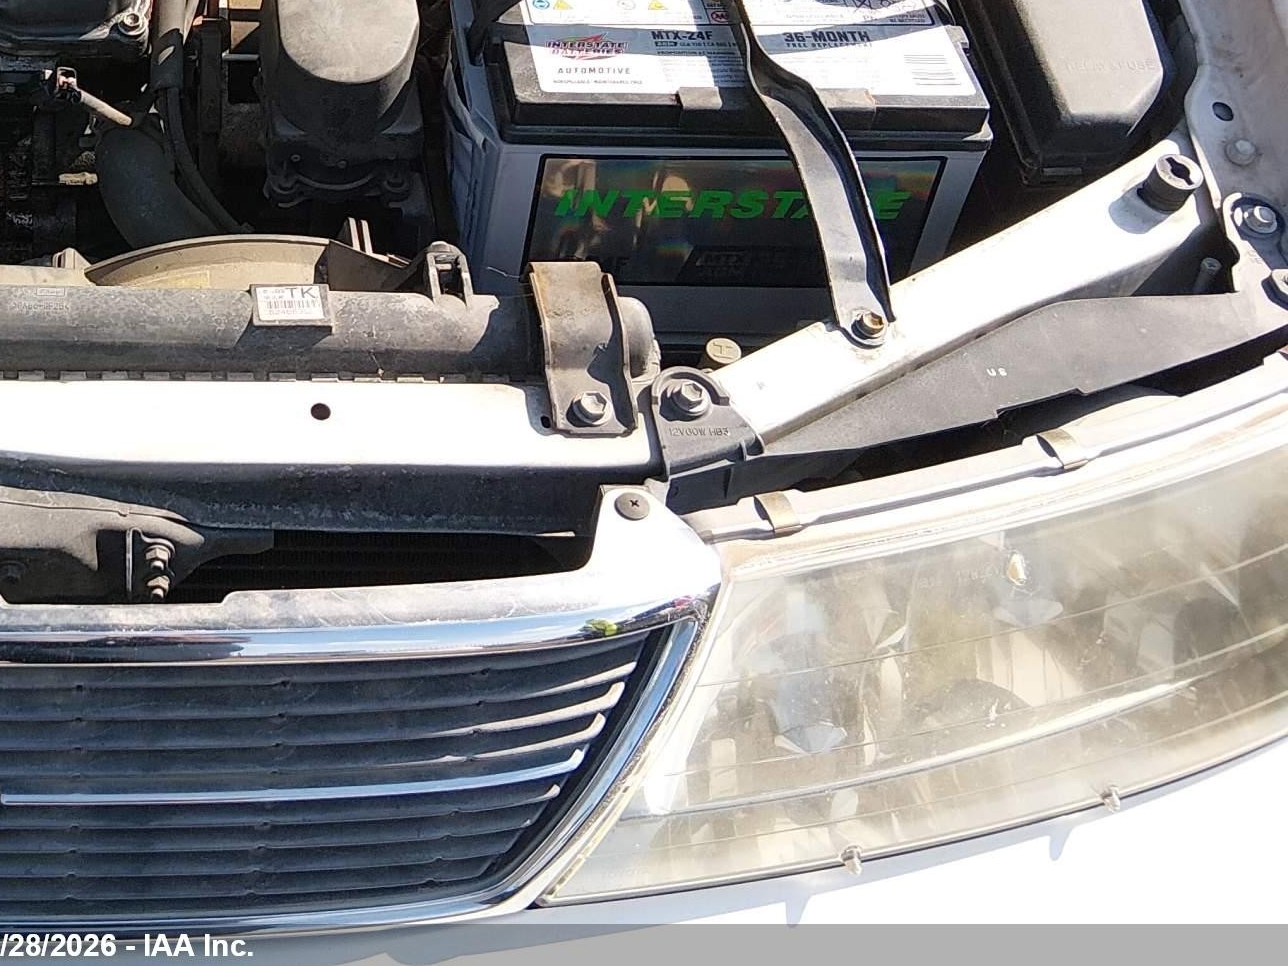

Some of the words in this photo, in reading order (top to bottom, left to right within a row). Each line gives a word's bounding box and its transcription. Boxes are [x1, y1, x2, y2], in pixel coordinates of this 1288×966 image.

[784, 30, 871, 43] 36-MONTH
[546, 41, 626, 49] INTERSTATE
[557, 67, 632, 75] AUTOMOTIVE
[285, 286, 316, 299] TK
